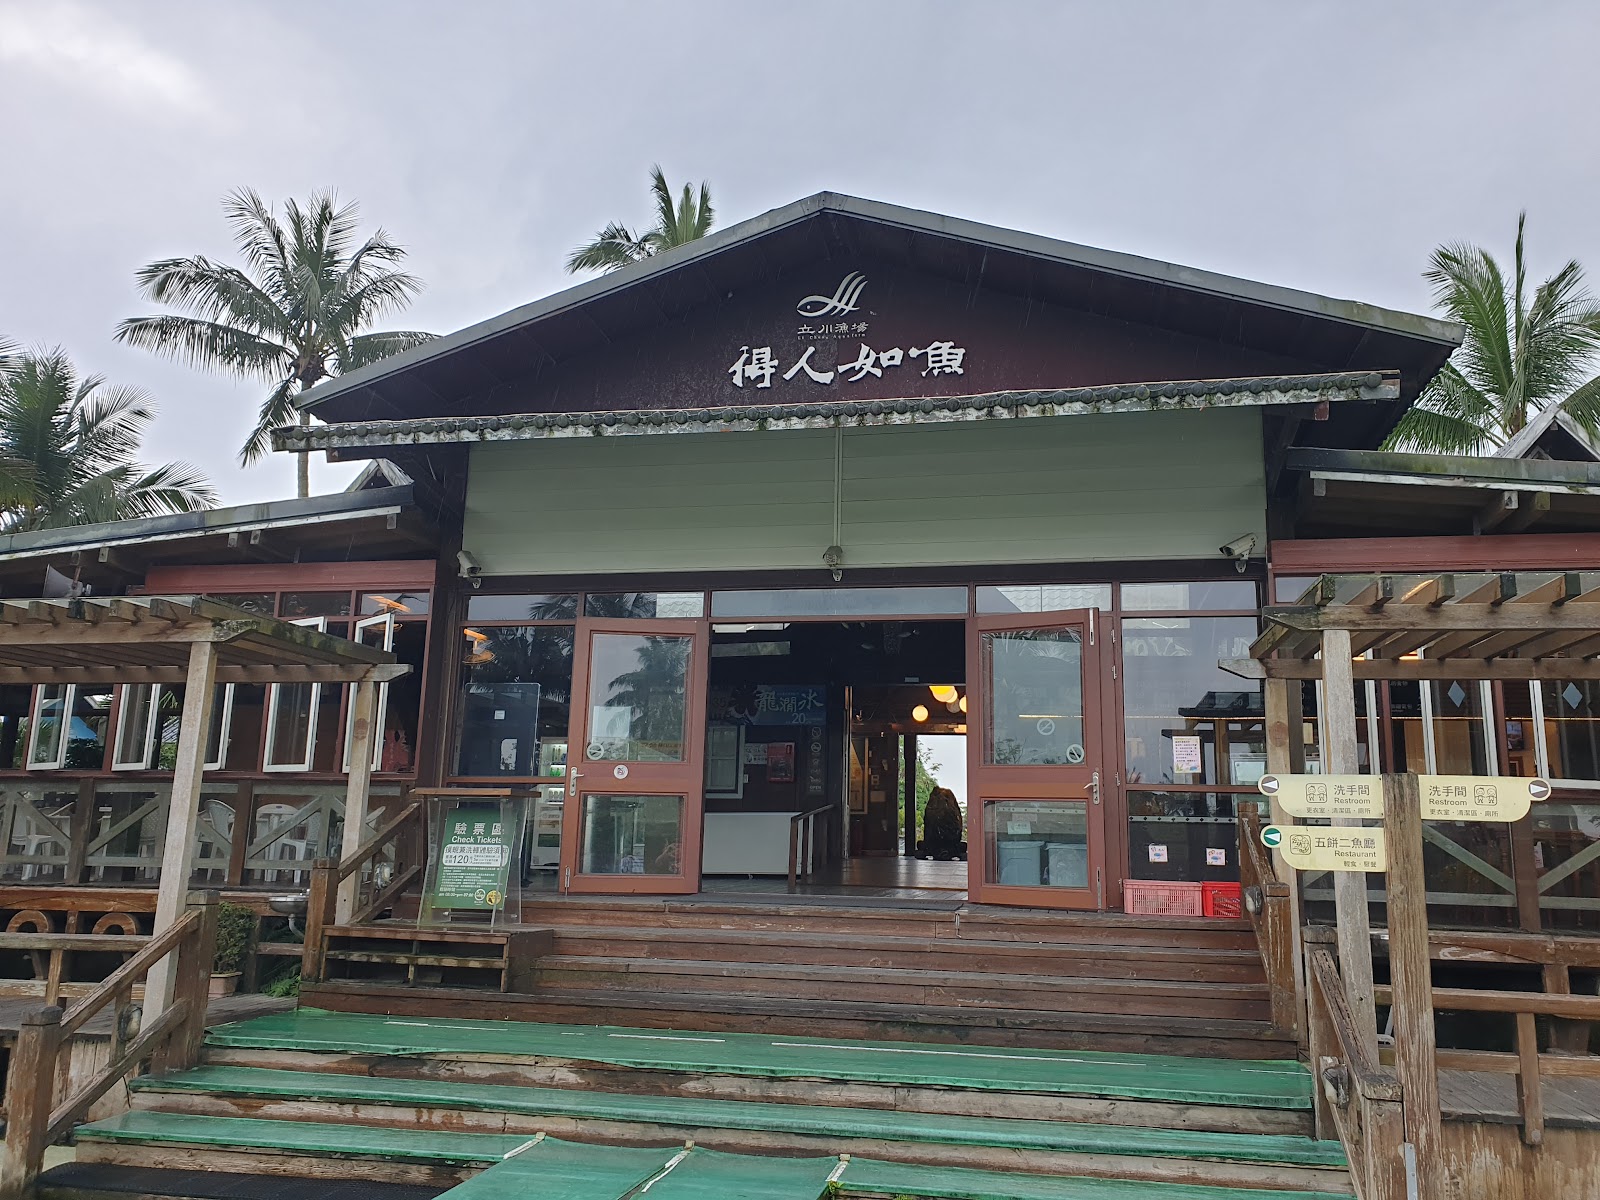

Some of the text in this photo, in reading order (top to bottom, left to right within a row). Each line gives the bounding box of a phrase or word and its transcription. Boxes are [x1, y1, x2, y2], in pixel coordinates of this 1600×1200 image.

[797, 321, 869, 334] 立川漁場
[728, 341, 966, 388] 得人如魚
[792, 712, 806, 724] 20
[1334, 784, 1370, 796] 洗手間
[1428, 785, 1467, 797] 洗手間
[1428, 798, 1467, 806] Restroom
[454, 822, 504, 836] 驗票區
[451, 835, 502, 844] Check Tickets
[1314, 837, 1376, 849] 五餅二魚廳
[452, 855, 469, 864] 120
[1334, 850, 1377, 858] Restaurant
